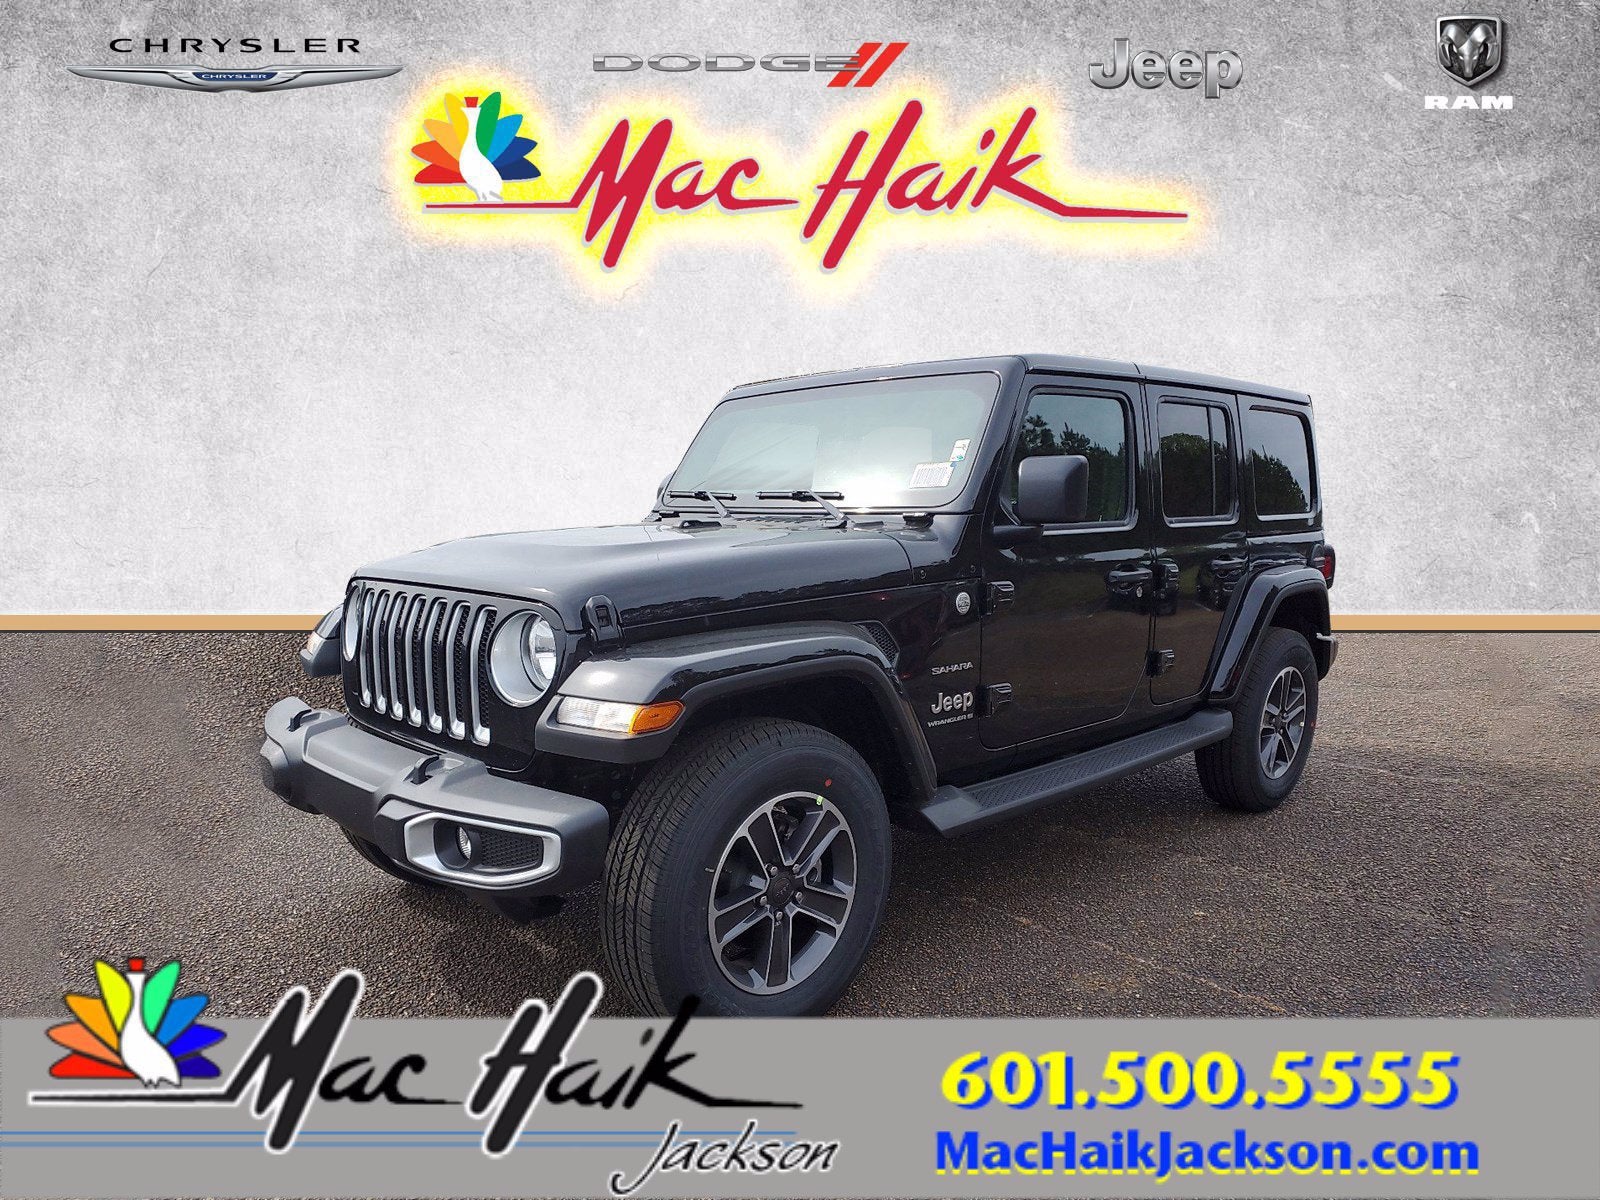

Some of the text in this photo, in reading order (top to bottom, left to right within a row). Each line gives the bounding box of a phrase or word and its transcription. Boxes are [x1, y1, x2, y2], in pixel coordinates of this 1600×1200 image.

[932, 661, 973, 675] SAHARA
[931, 692, 974, 714] Jeep
[928, 714, 967, 727] WRANGLER
